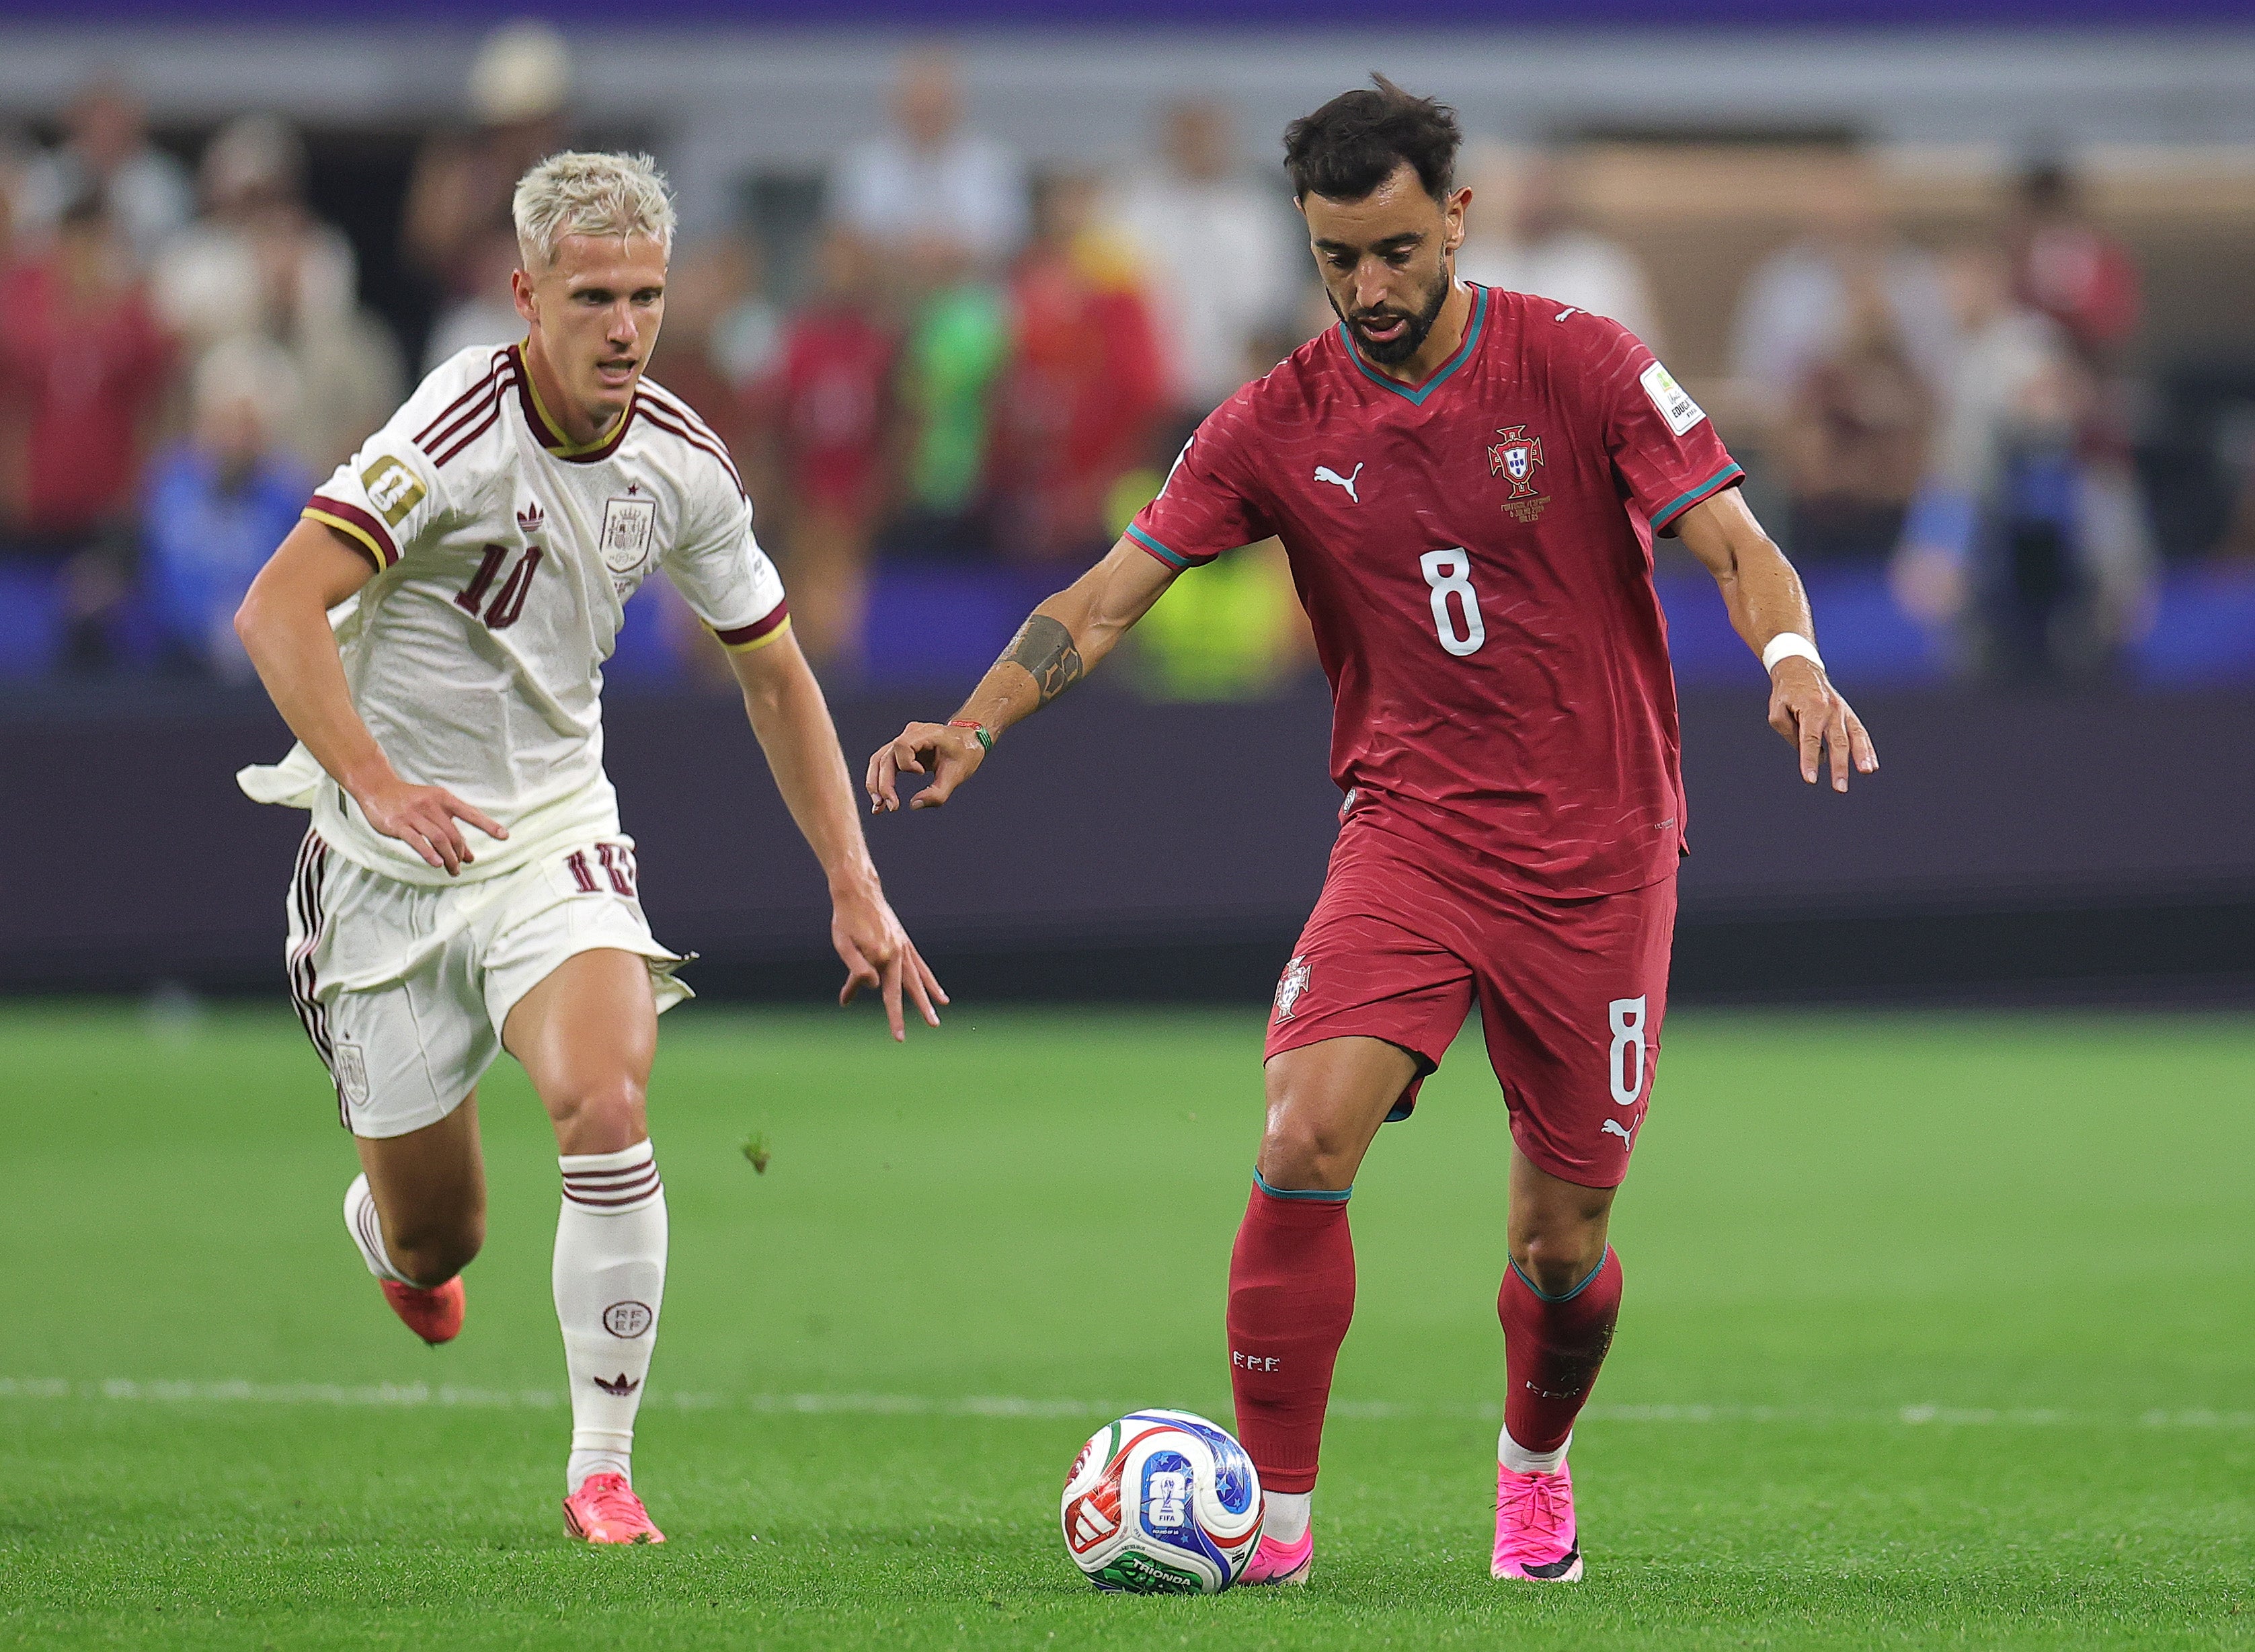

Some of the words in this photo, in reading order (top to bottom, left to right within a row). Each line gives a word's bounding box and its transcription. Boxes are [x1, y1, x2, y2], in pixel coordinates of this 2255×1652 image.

[453, 543, 544, 630] 10
[1419, 547, 1485, 657] 8
[1609, 994, 1647, 1105] 8
[1133, 1558, 1191, 1585] TRIONDA
